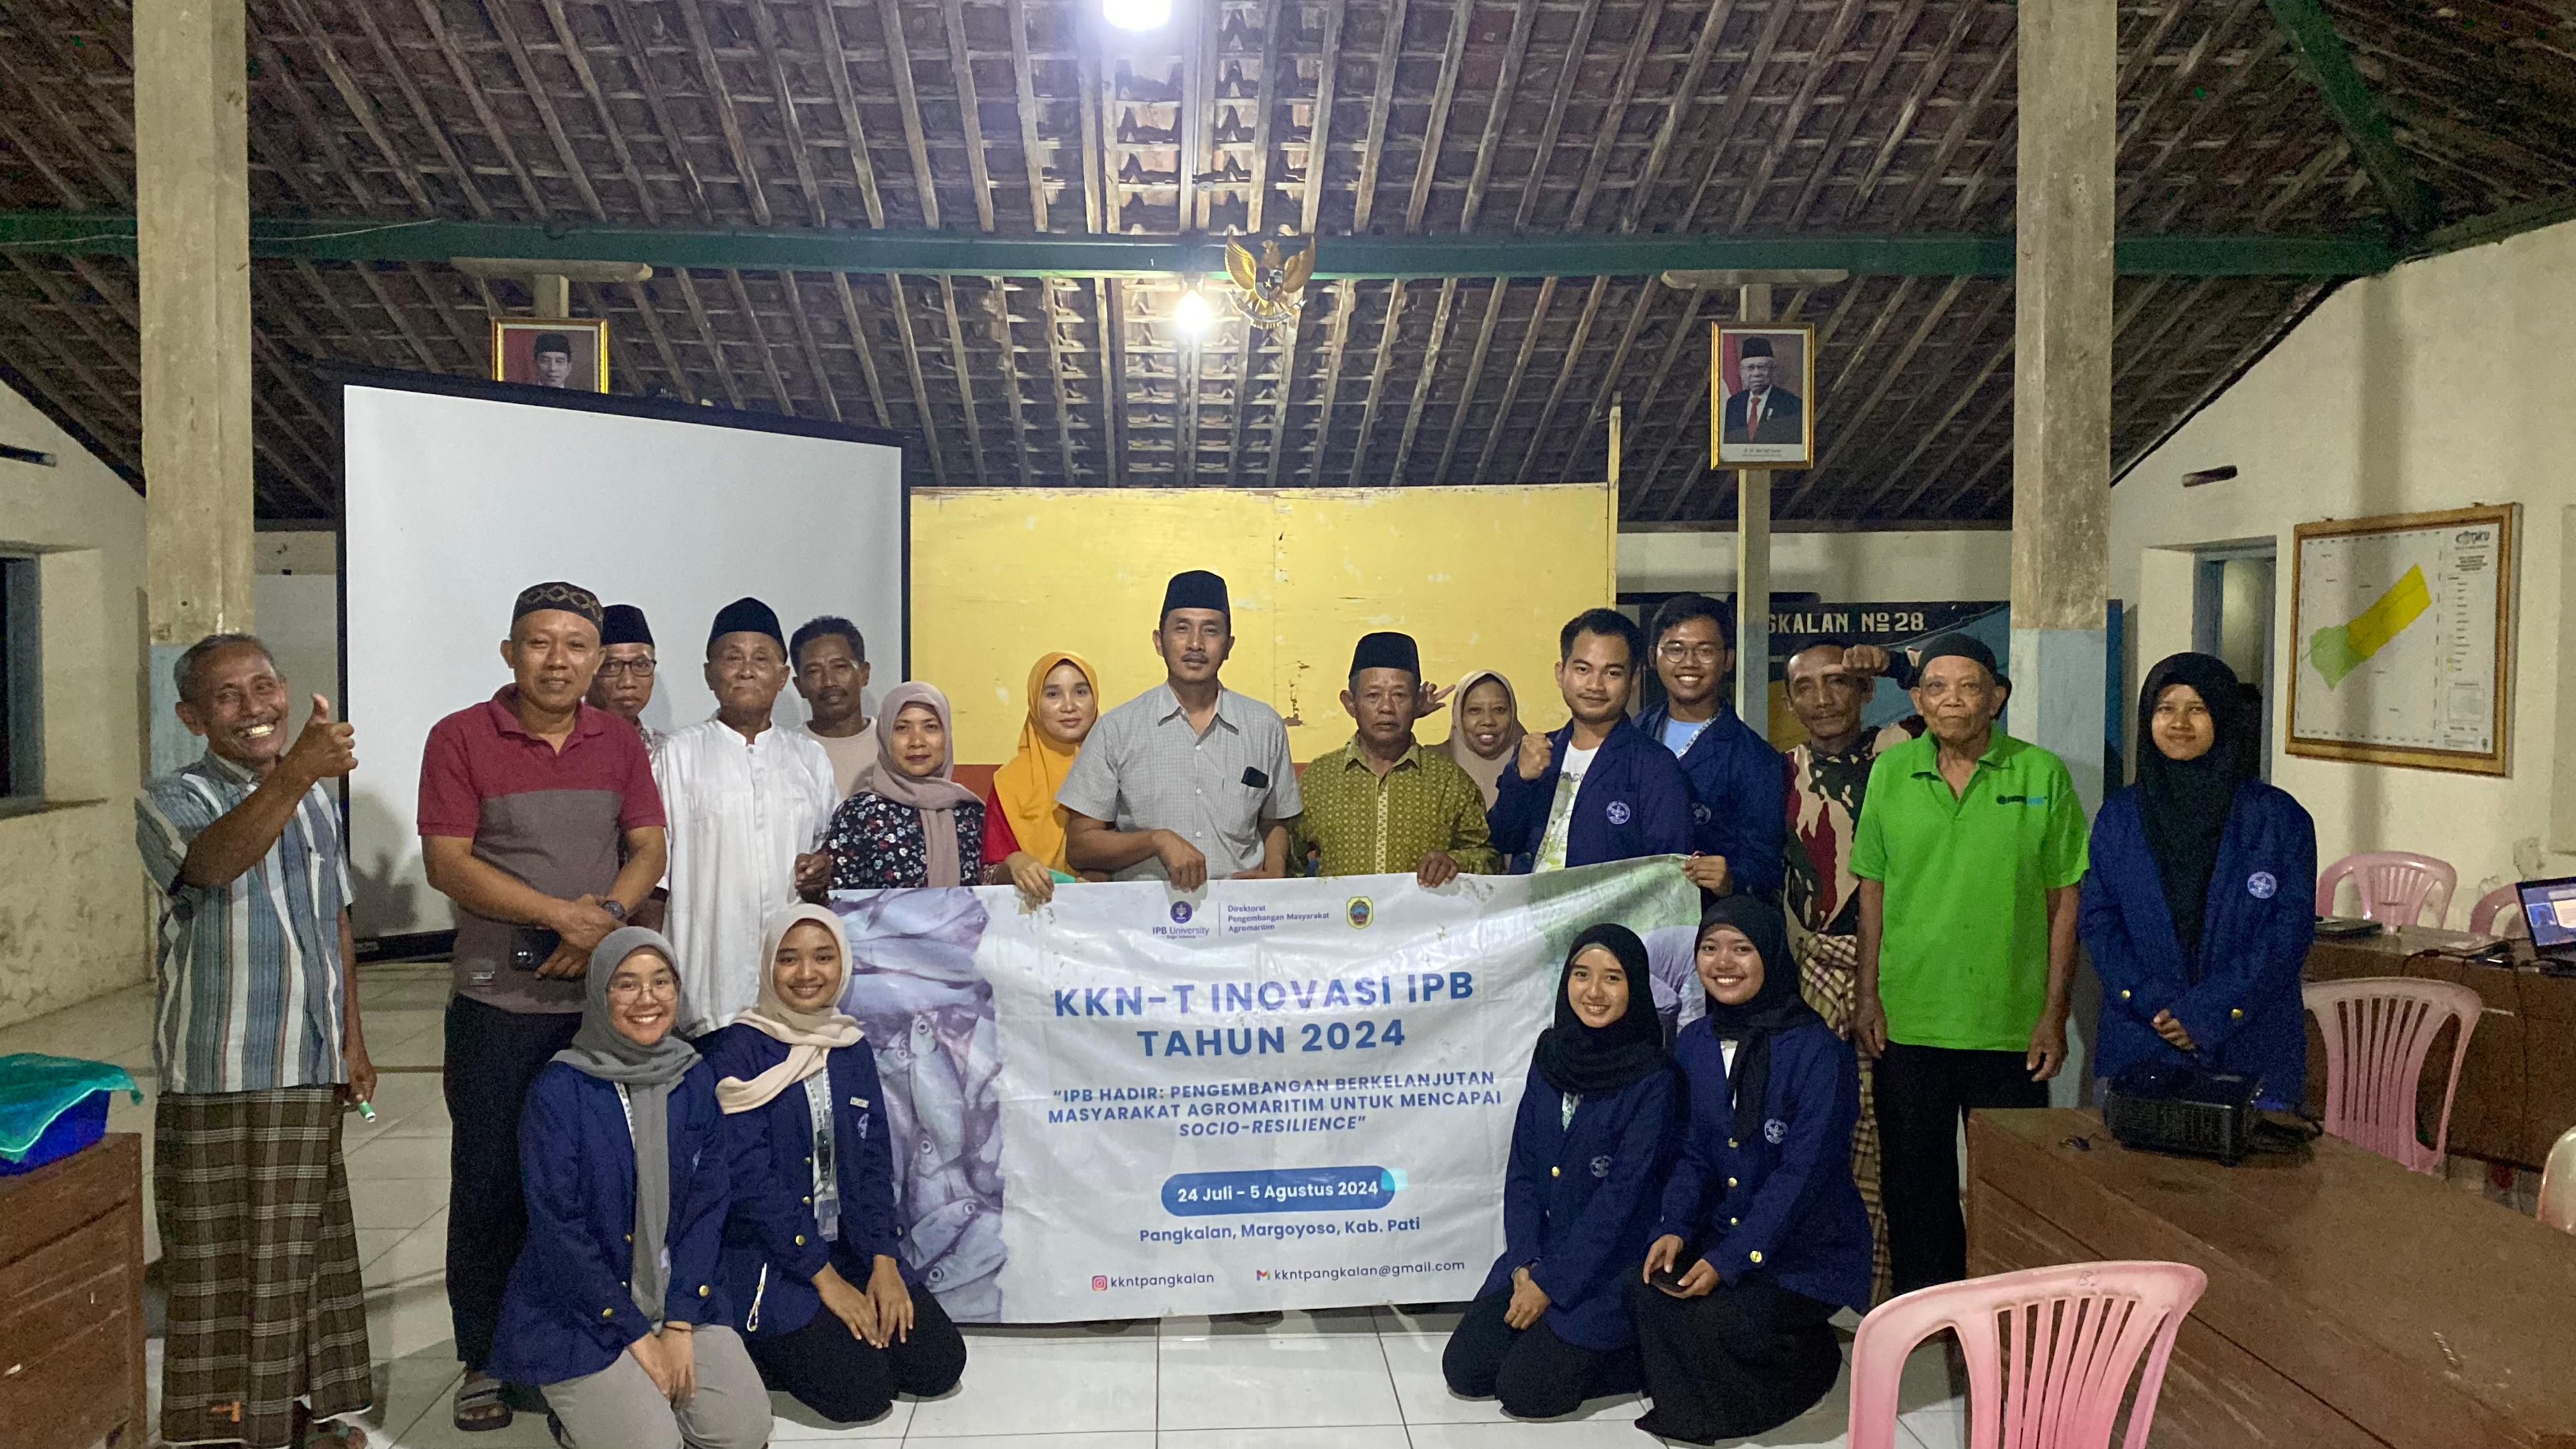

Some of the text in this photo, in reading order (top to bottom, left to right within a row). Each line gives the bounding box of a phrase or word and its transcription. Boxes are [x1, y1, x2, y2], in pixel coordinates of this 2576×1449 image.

[1227, 905, 1266, 913] Direktorat
[1227, 912, 1330, 924] Pengembangan Masyarakat
[1152, 926, 1210, 937] IPB University
[1227, 924, 1275, 933] Agromaritim
[1054, 971, 1474, 1017] KKN-T INOVASI IPB
[1137, 1018, 1406, 1057] TAHUN 2024
[1100, 1086, 1165, 1102] HADIR:
[1170, 1078, 1329, 1099] PENGEMBANGAN
[1335, 1071, 1495, 1091] BERKELANJUTAN
[1048, 1091, 1501, 1124] MASYARAKAT AGROMARITIM UNTUK MENCAPAI
[1177, 1188, 1199, 1202] 24
[1202, 1185, 1233, 1201] Juli
[1250, 1186, 1261, 1199] 5
[1264, 1183, 1334, 1202] Agustus
[1337, 1181, 1379, 1197] 2024
[1139, 1216, 1420, 1245] Pangkalan, Margoyoso, Kab. Pati
[1110, 1260, 1465, 1289] kkntpangkalan kkntpangkalan@gmail.com
